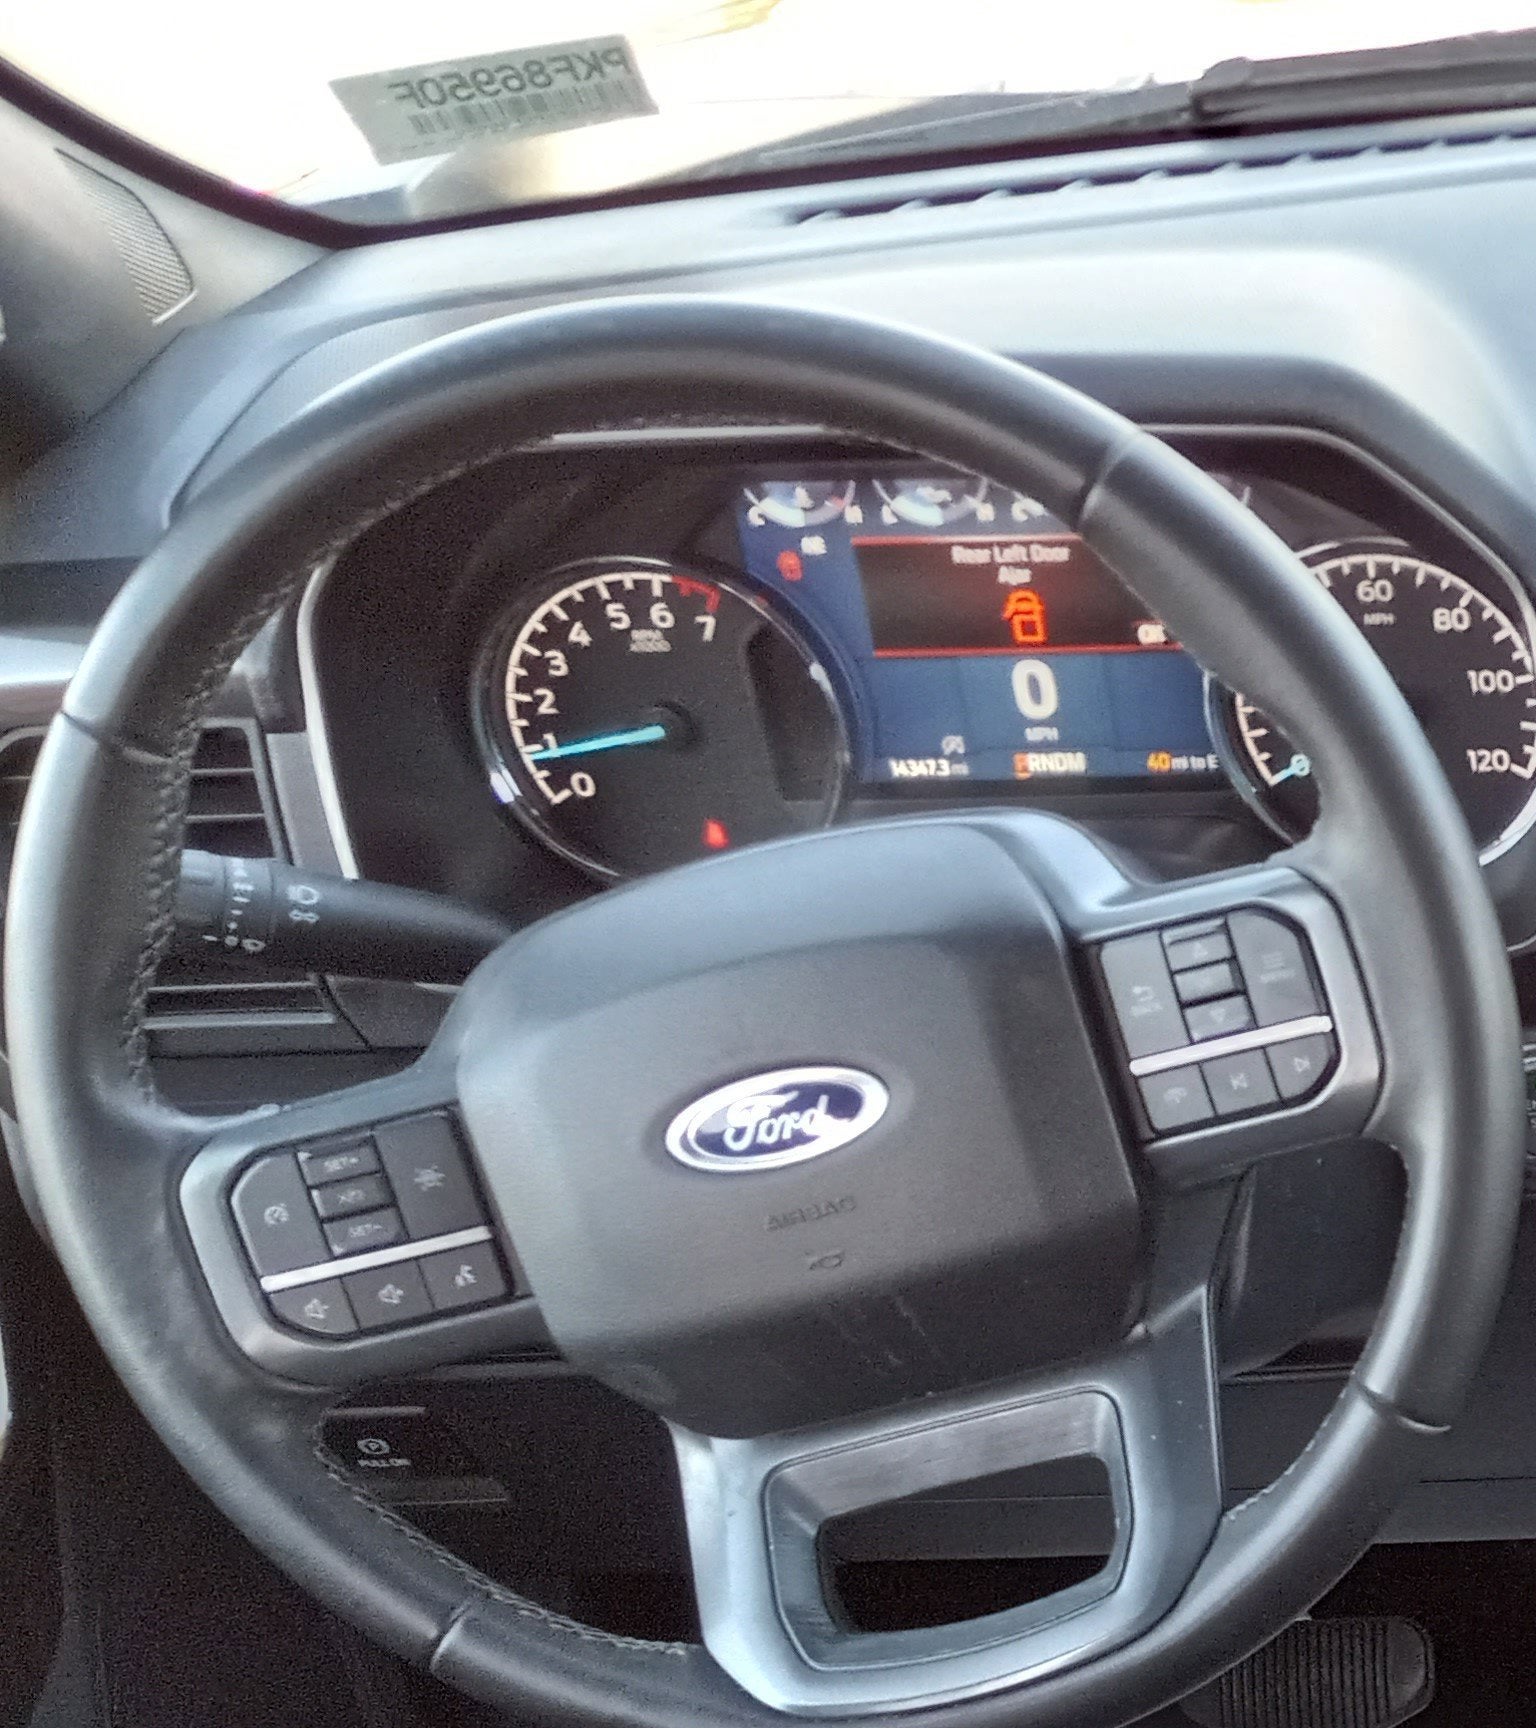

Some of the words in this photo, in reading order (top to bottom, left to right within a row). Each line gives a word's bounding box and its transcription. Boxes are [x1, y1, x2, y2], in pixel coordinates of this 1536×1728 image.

[1356, 580, 1394, 603] 60
[605, 602, 631, 630] 5
[649, 602, 675, 629] 6
[694, 615, 717, 642] 7
[1433, 607, 1471, 633] 80
[568, 621, 592, 648] 4
[545, 650, 569, 677] 3
[1012, 659, 1058, 720] 0
[1467, 670, 1515, 694] 100
[535, 688, 560, 715] 2
[543, 733, 561, 757] 1
[1466, 749, 1510, 773] 120
[570, 773, 597, 797] 0
[723, 1090, 832, 1151] Ford
